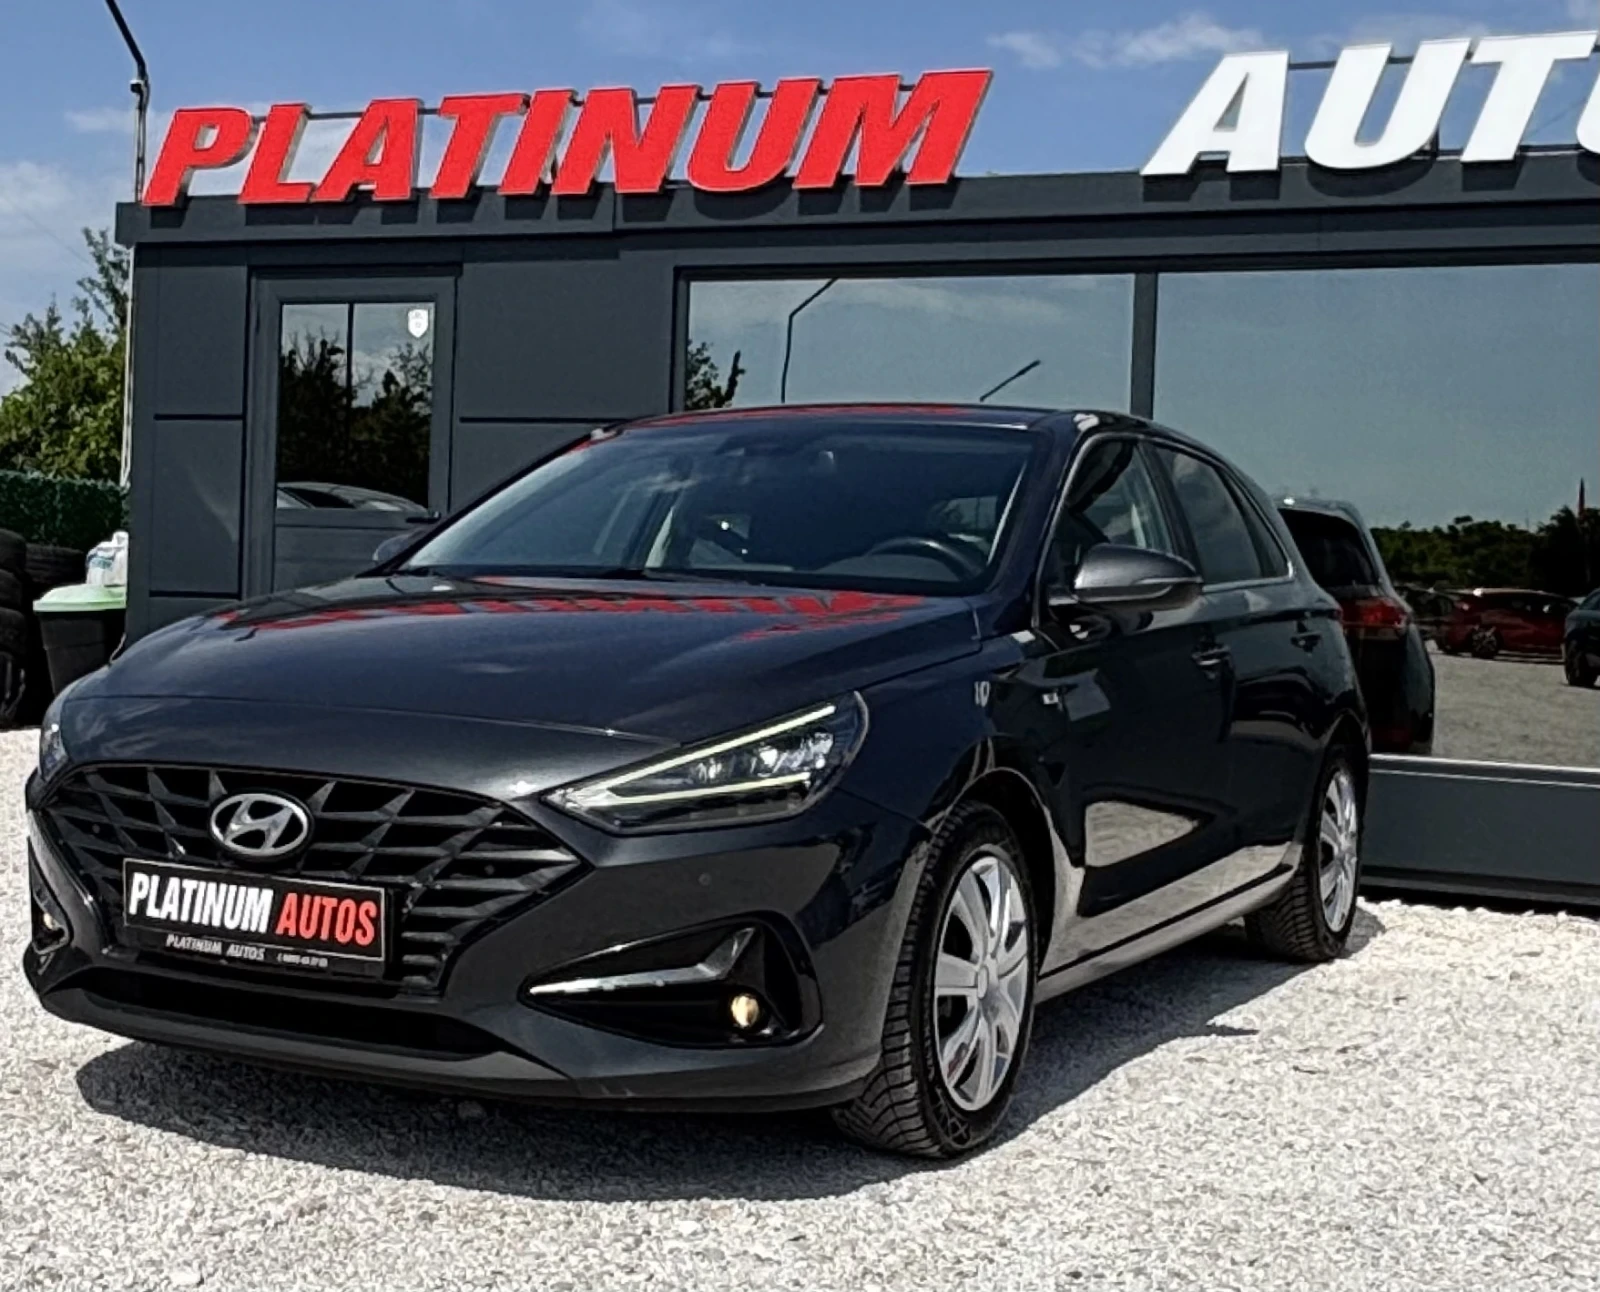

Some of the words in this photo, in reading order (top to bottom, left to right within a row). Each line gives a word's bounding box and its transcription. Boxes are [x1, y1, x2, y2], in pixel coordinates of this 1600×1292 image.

[142, 68, 993, 207] PLATINUM
[128, 871, 274, 935] PLATINUM
[275, 892, 378, 946] AUTOS
[165, 933, 223, 956] PLATINUM
[226, 943, 266, 961] AUTOS
